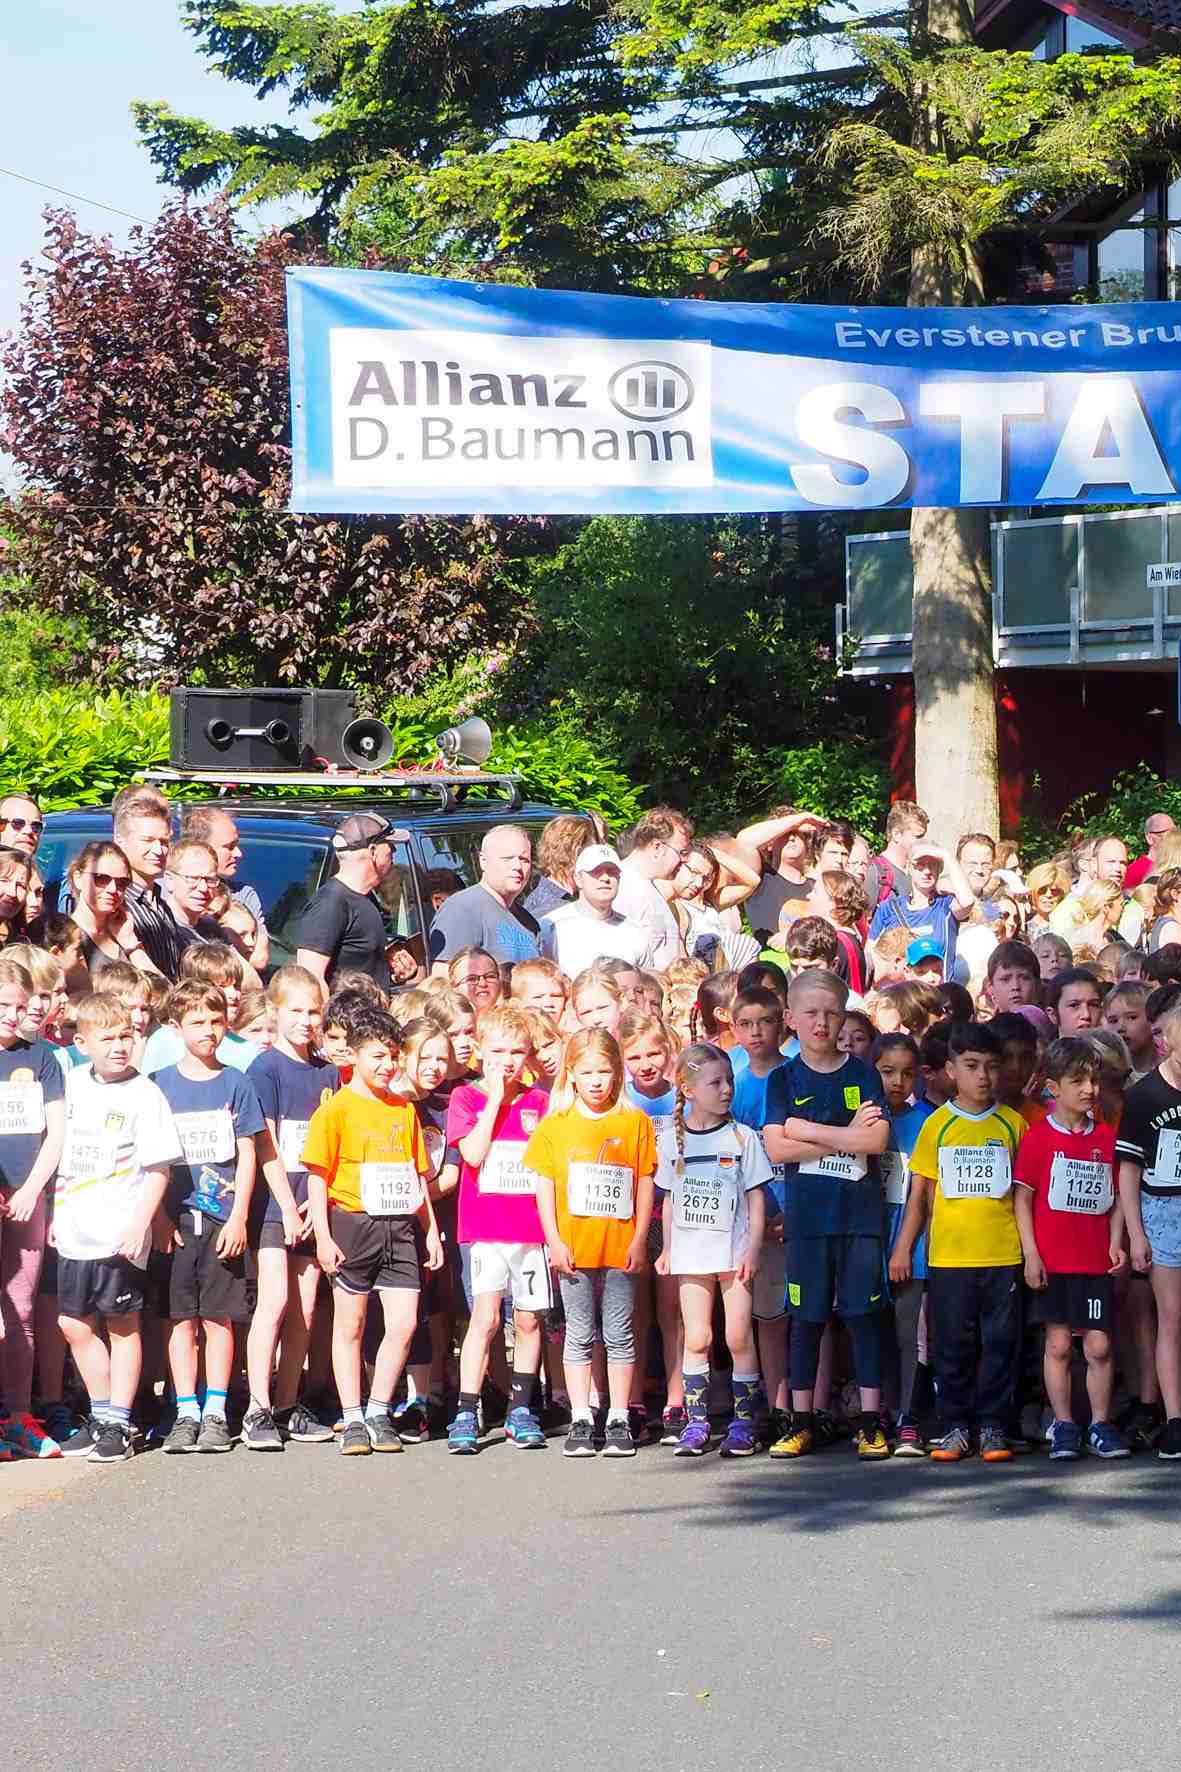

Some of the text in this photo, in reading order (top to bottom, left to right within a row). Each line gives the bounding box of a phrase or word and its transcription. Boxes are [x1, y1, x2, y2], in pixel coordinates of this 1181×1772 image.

[836, 321, 1087, 350] Everstener
[348, 360, 587, 409] Allianz
[348, 415, 696, 462] D. Baumann
[1150, 567, 1163, 581] Am
[954, 1148, 982, 1156] Allianz
[818, 1156, 852, 1174] bruns
[956, 1165, 993, 1178] 1128
[1067, 1161, 1095, 1172] Allianz
[380, 1182, 411, 1195] 1192
[683, 1177, 710, 1187] Allianz
[958, 1180, 991, 1193] bruns
[1067, 1179, 1102, 1195] 1125
[586, 1184, 621, 1199] 1136
[683, 1194, 719, 1210] 2673
[1067, 1193, 1098, 1209] bruns
[684, 1208, 716, 1224] bruns
[522, 1270, 537, 1296] 7
[1087, 1299, 1101, 1320] 10
